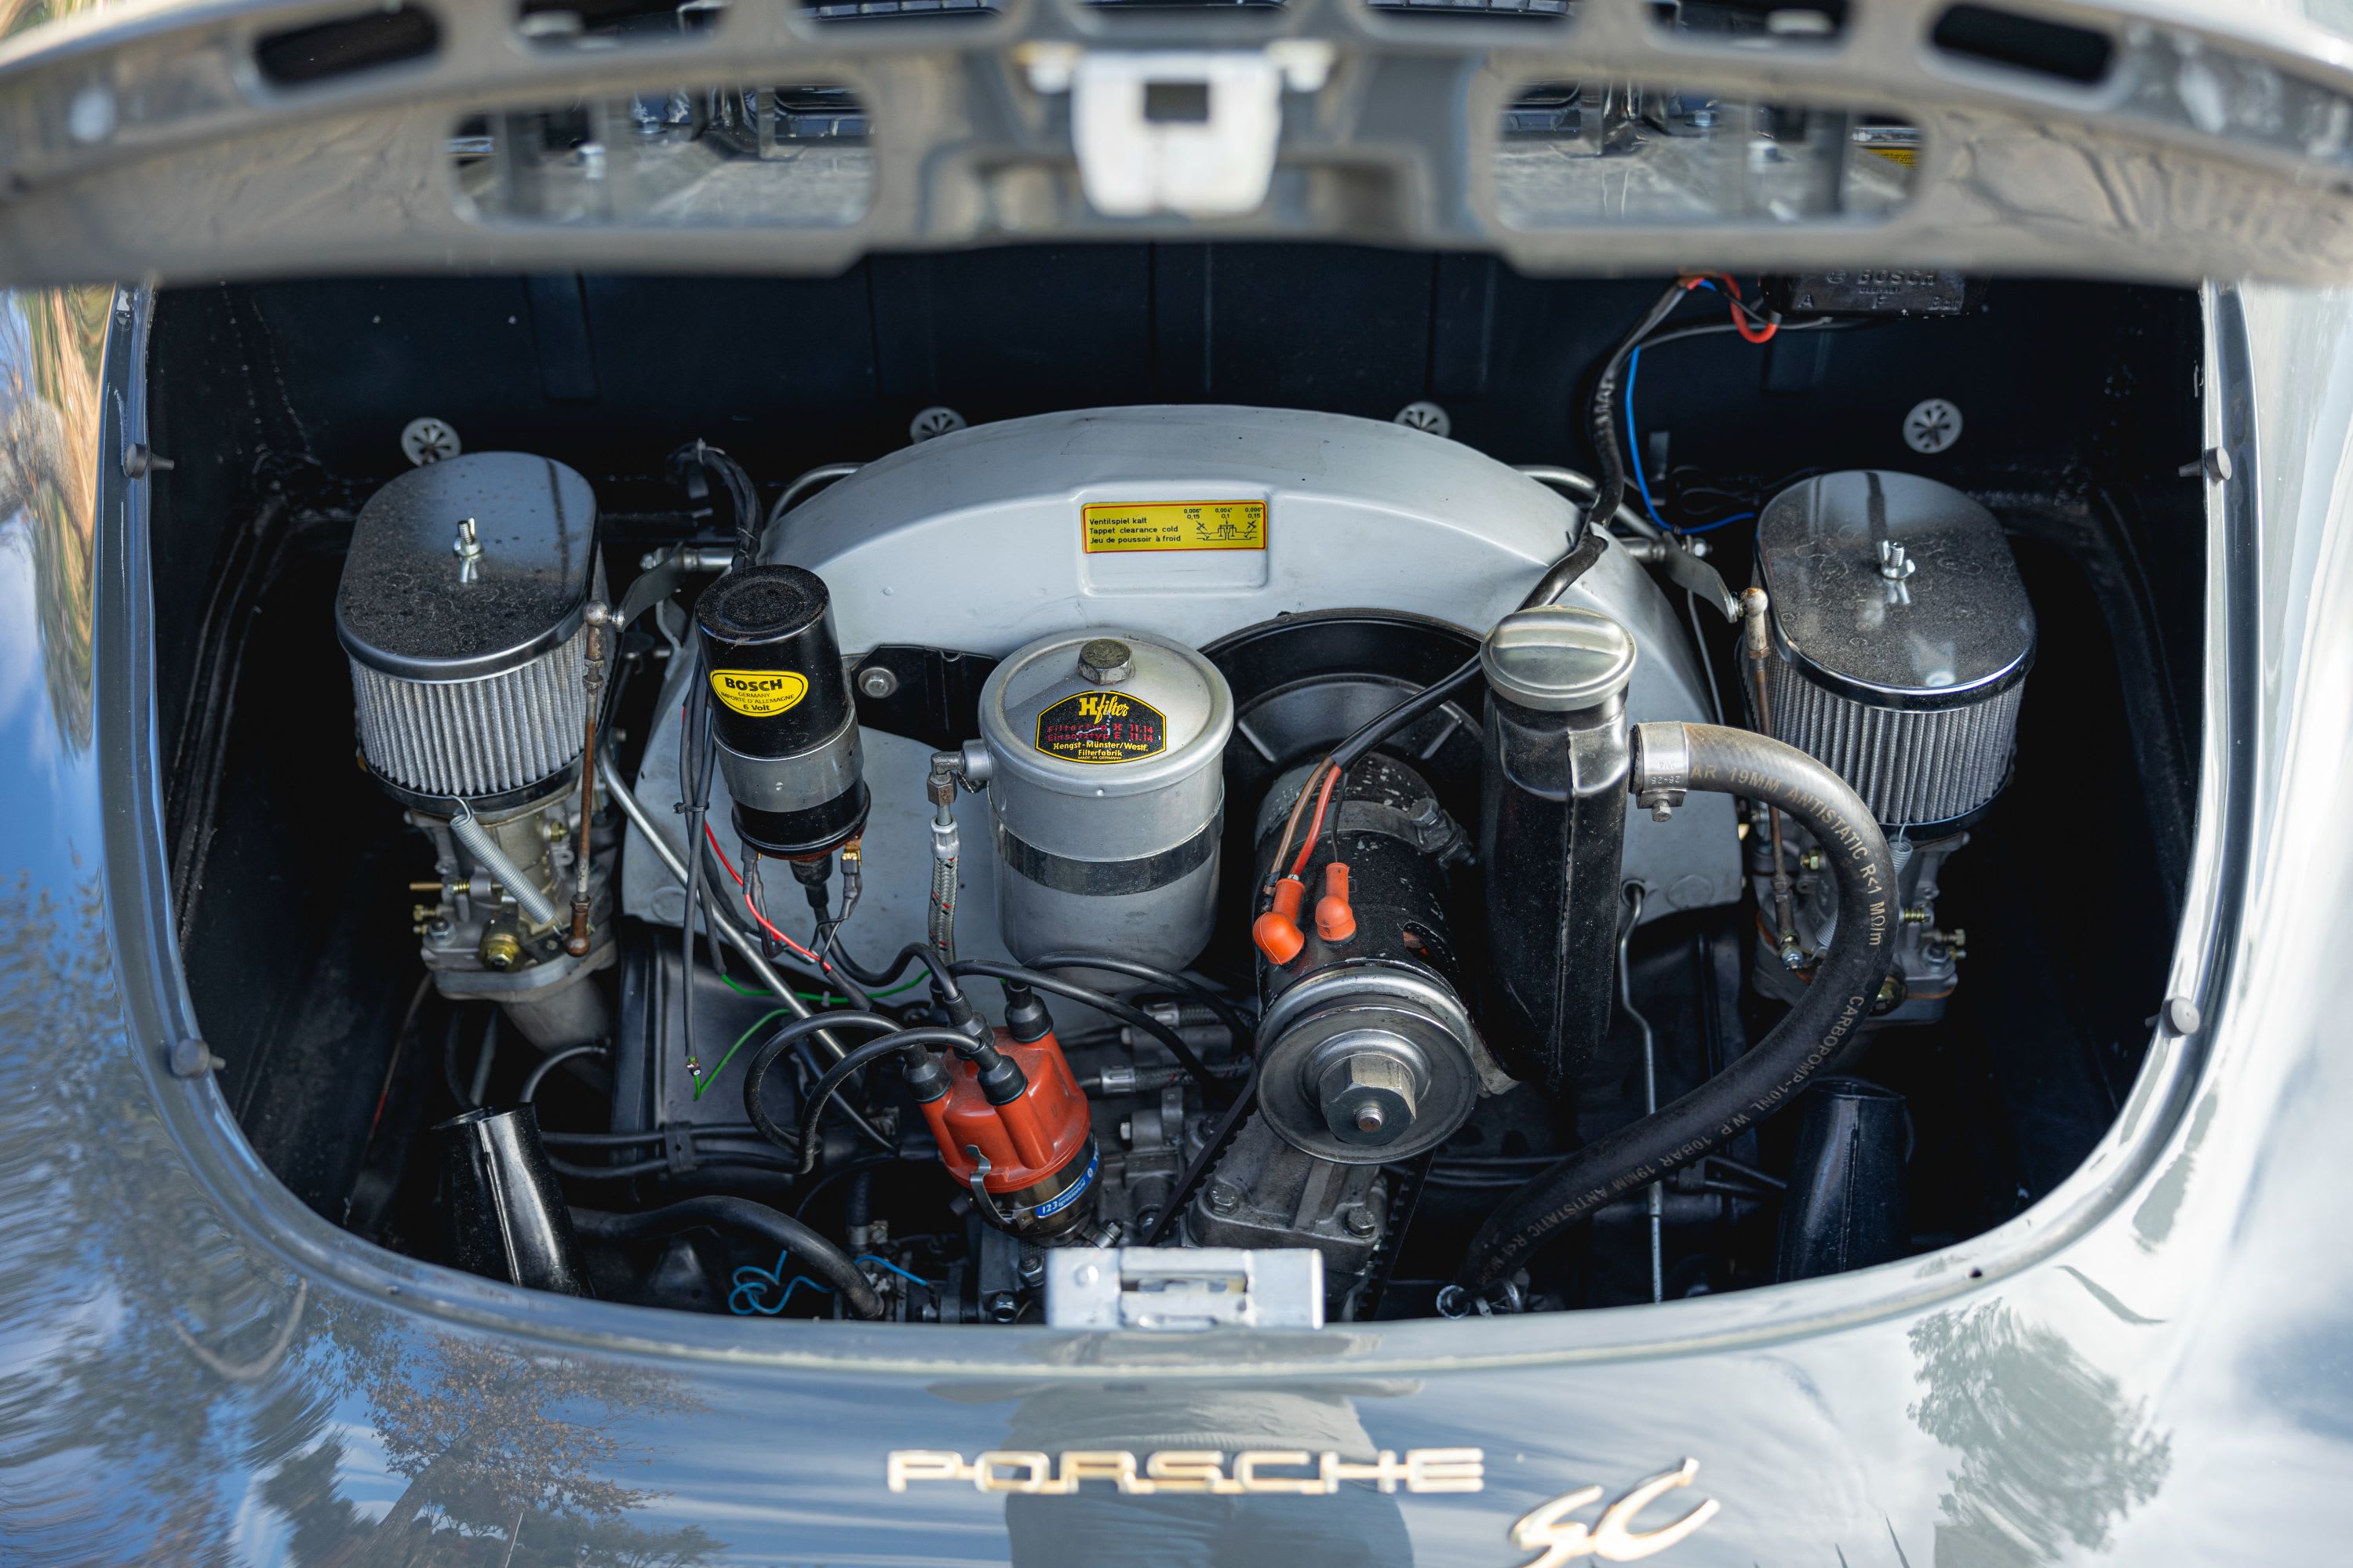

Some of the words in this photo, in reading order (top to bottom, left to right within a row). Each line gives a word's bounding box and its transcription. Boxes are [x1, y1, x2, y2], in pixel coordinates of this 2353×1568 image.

[1857, 269, 1935, 286] BOSCH
[1118, 536, 1152, 544] poussoir
[724, 677, 783, 692] BOSCH
[1047, 724, 1108, 734] Filtertyp
[1130, 723, 1153, 734] 11.14
[1130, 732, 1153, 743] 11.14
[1078, 748, 1123, 757] Filterfabrik
[1729, 767, 1783, 792] 19MM
[1785, 786, 1868, 860] ANTISTATIC
[1658, 1135, 1712, 1167] 10BAR
[1042, 1201, 1058, 1214] 123
[1527, 1185, 1608, 1237] ANTISTATIC
[887, 1447, 1485, 1496] PORSCHE
[1510, 1457, 1721, 1568] SC
